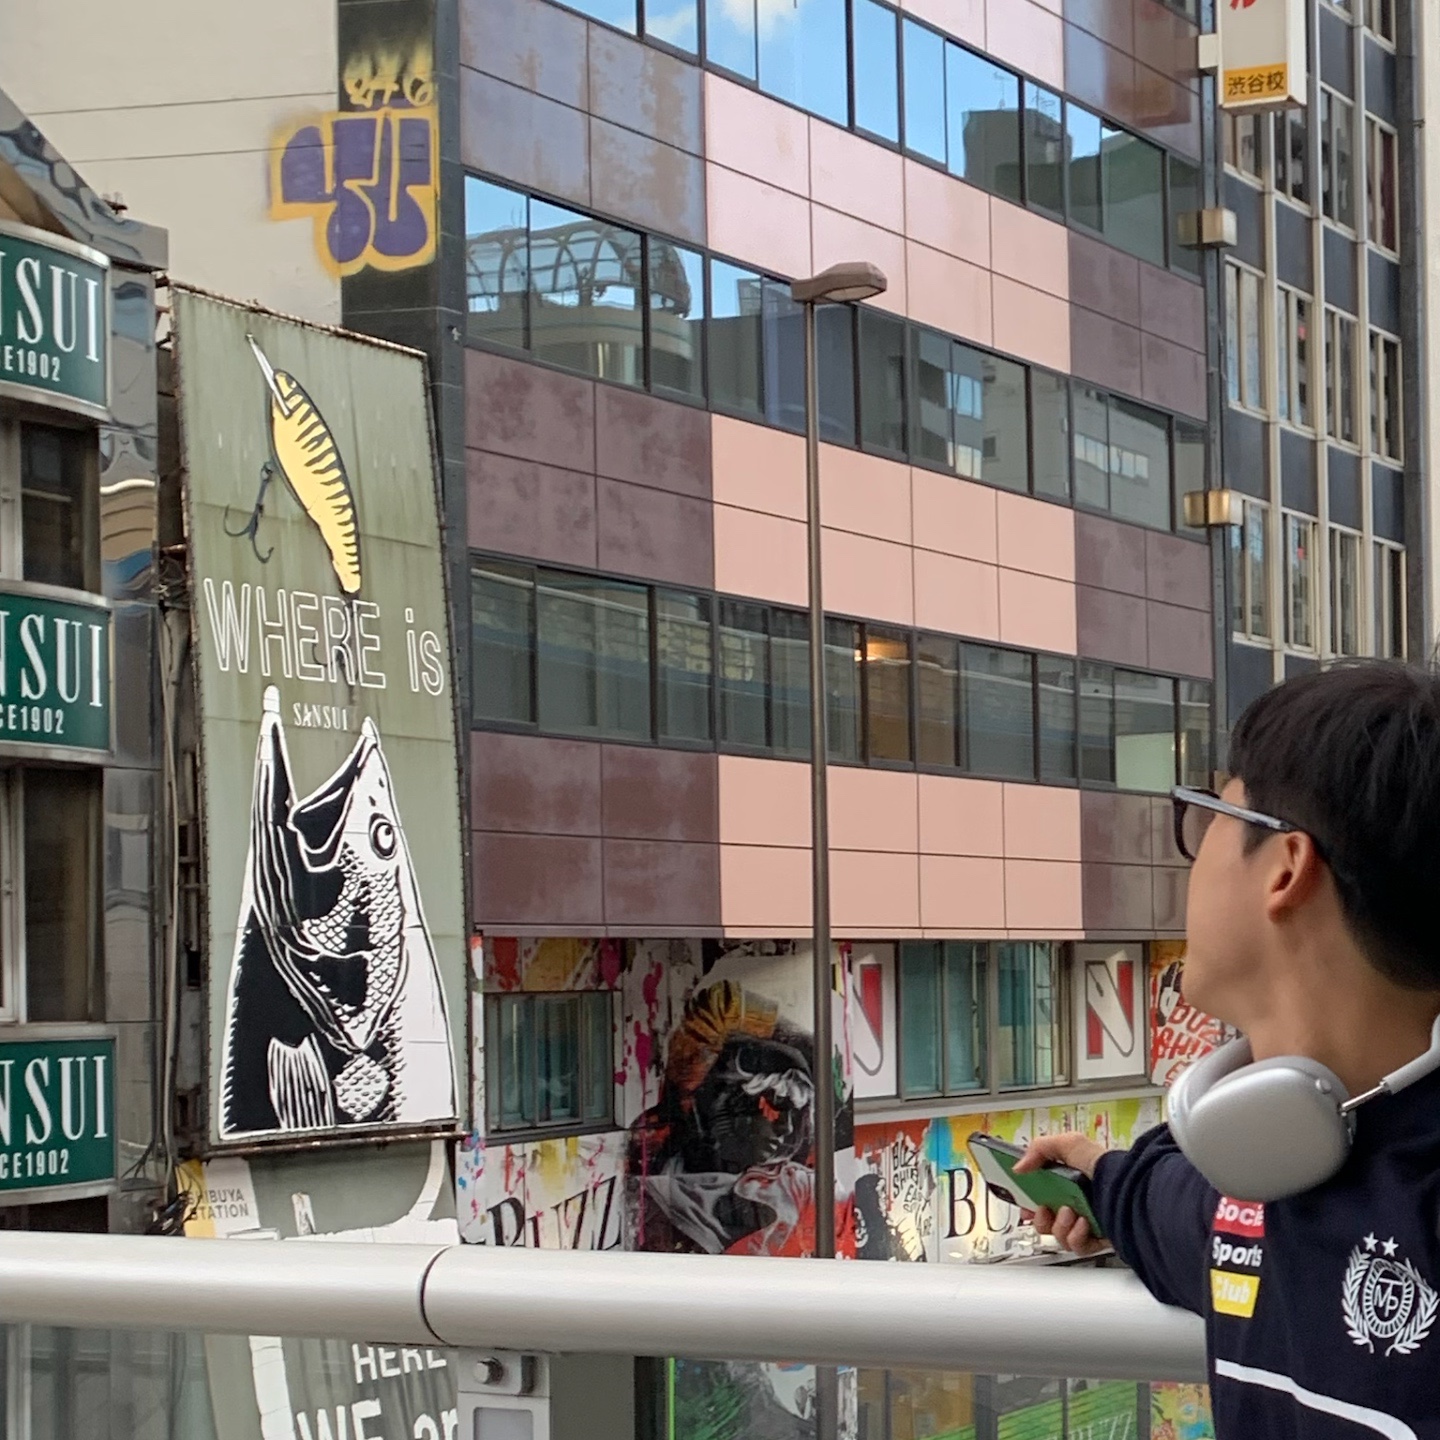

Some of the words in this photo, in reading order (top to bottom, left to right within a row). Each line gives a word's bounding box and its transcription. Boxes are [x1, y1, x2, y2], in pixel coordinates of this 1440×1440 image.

[1228, 71, 1284, 96] 渋谷校
[0, 252, 99, 363] SUI
[204, 577, 386, 689] WHERE
[405, 607, 444, 696] is
[0, 703, 64, 734] E1902
[293, 703, 349, 731] SANSUI
[1212, 1236, 1263, 1267] Sports
